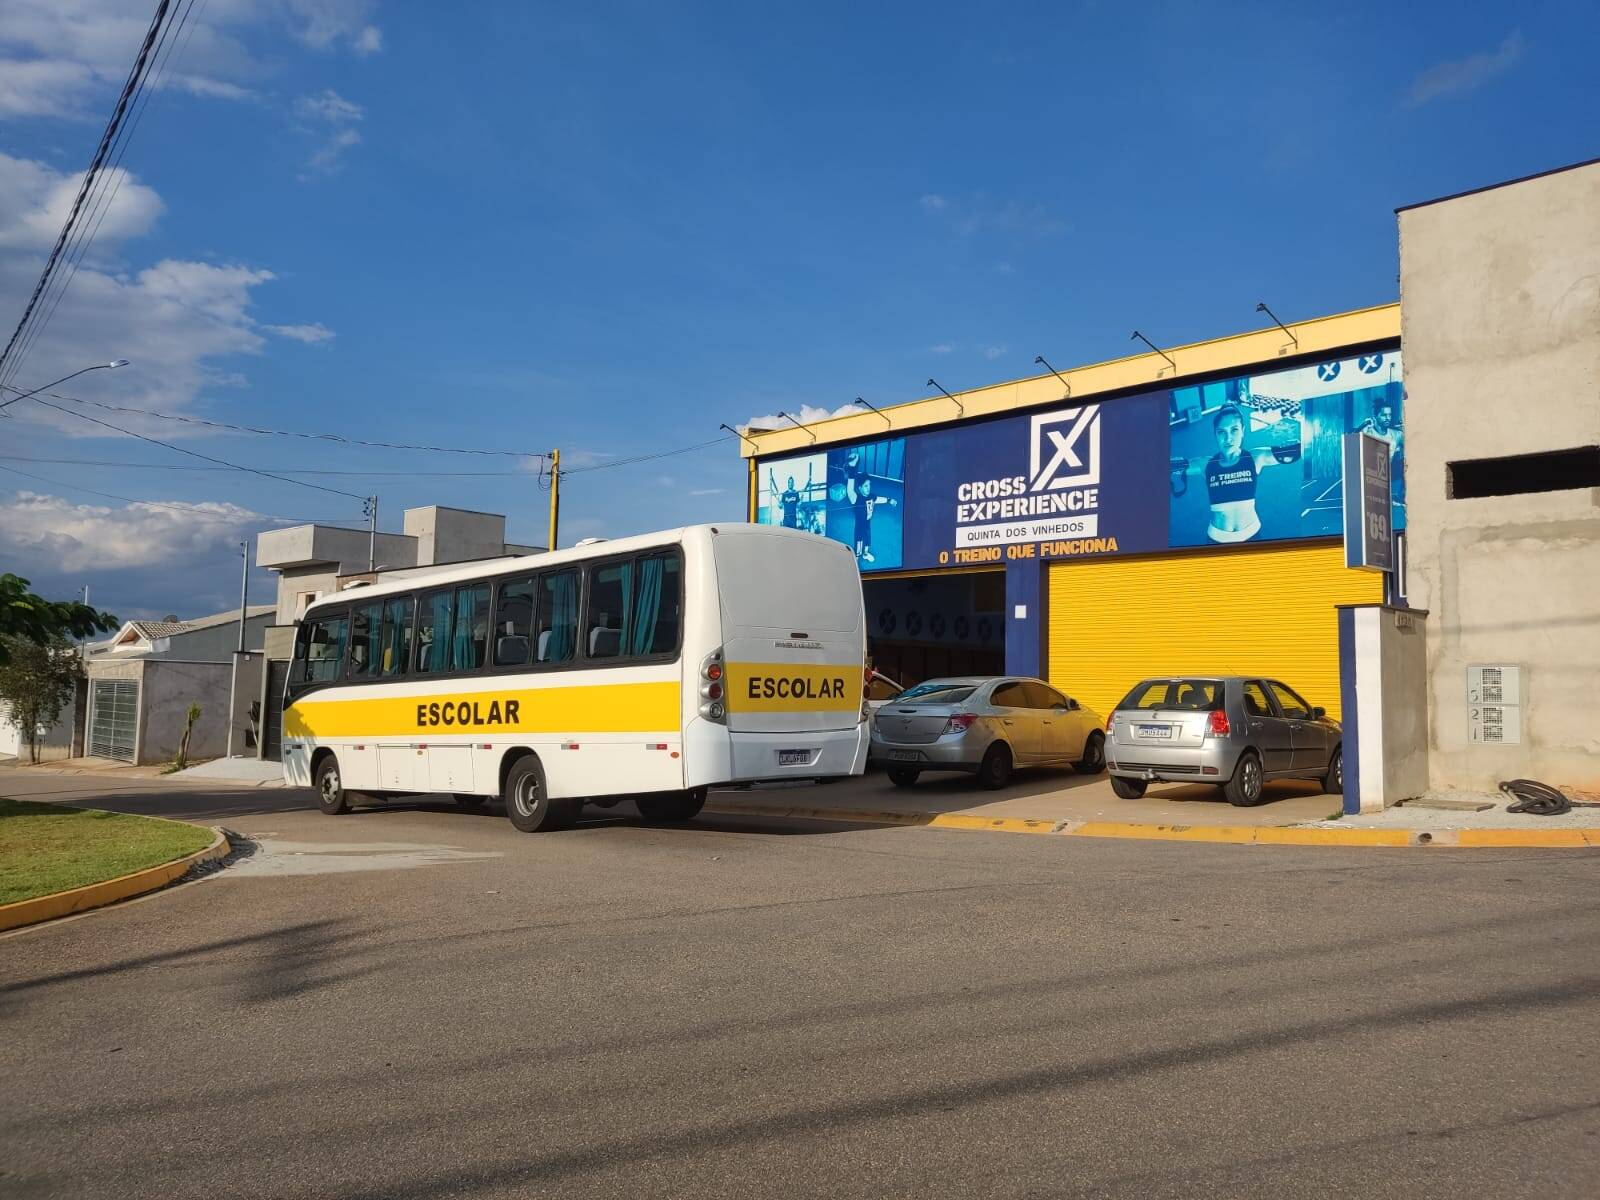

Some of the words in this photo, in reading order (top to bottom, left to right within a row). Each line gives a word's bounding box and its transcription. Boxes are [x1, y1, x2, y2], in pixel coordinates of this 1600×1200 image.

[1218, 470, 1251, 480] TREINO
[957, 476, 1026, 502] CROSS
[956, 489, 1099, 523] EXPERIENCE
[967, 529, 1001, 541] QUINTA
[1006, 527, 1027, 538] DOS
[1032, 522, 1084, 536] VINHEDOS
[939, 551, 948, 564] O
[953, 547, 1001, 563] TREINO
[1006, 544, 1035, 560] QUE
[1040, 537, 1118, 557] FUNCIONA
[748, 677, 845, 699] ESCOLAR
[417, 700, 520, 727] ESCOLAR
[1471, 709, 1479, 720] 2
